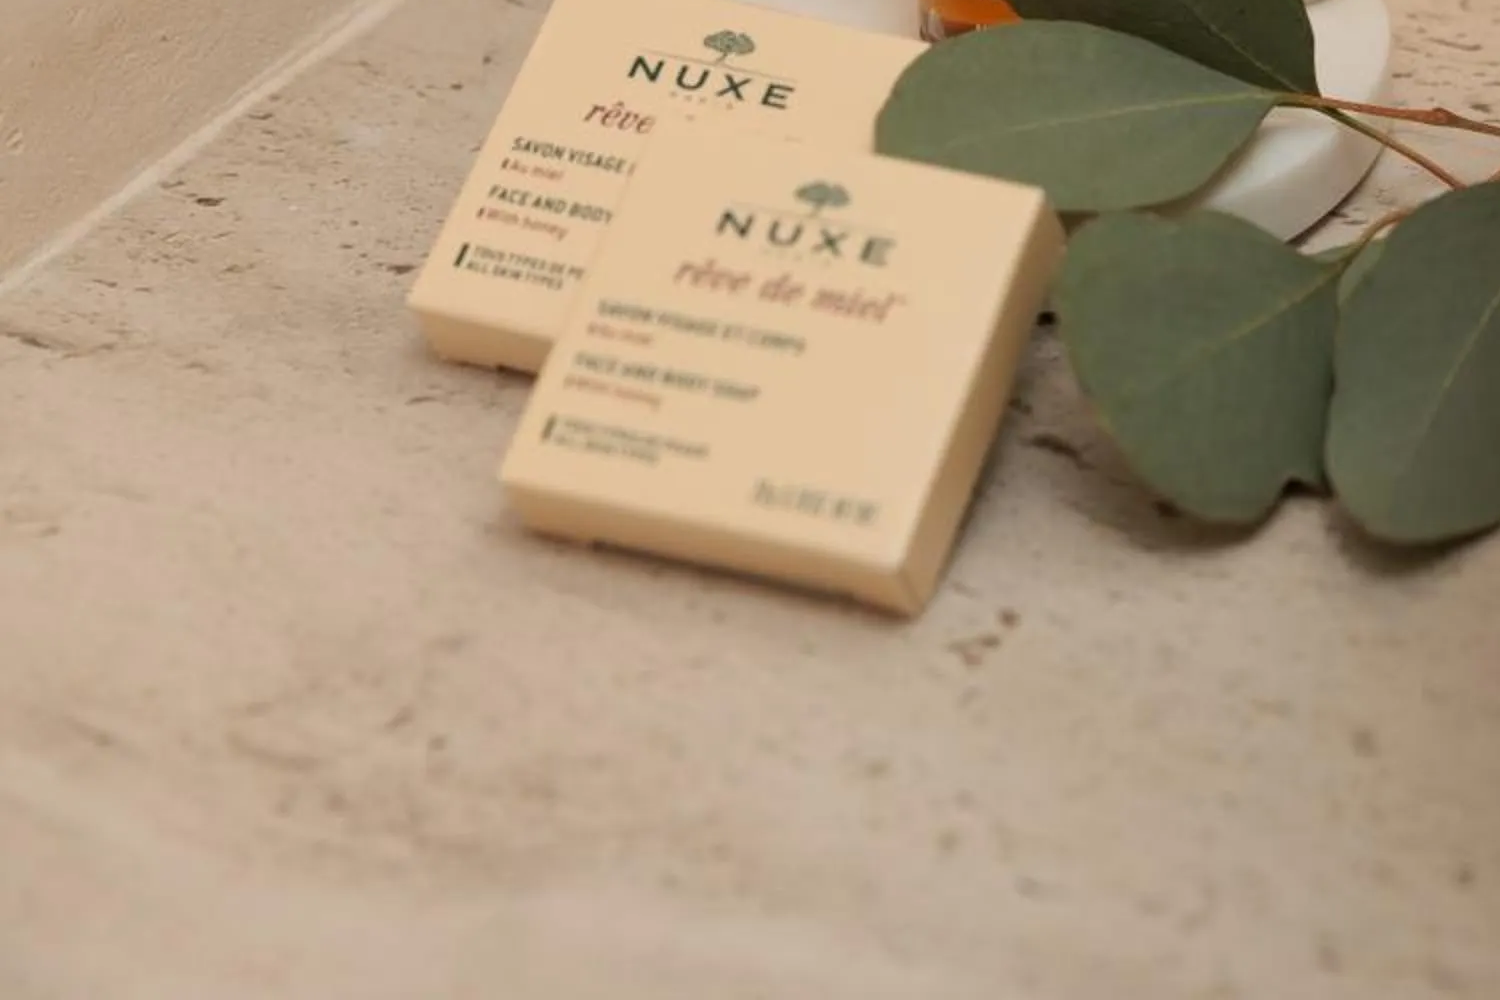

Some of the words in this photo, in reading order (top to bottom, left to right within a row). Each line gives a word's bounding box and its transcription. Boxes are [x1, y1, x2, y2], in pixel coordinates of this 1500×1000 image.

[627, 55, 796, 110] NUXE
[583, 100, 656, 134] rêve
[511, 136, 567, 162] SAVON
[567, 147, 628, 175] VISAGE
[487, 183, 532, 207] FACE
[531, 195, 569, 215] AND
[568, 201, 614, 224] BODY
[714, 208, 897, 267] NUXE
[672, 259, 752, 294] rêve
[757, 272, 805, 305] de
